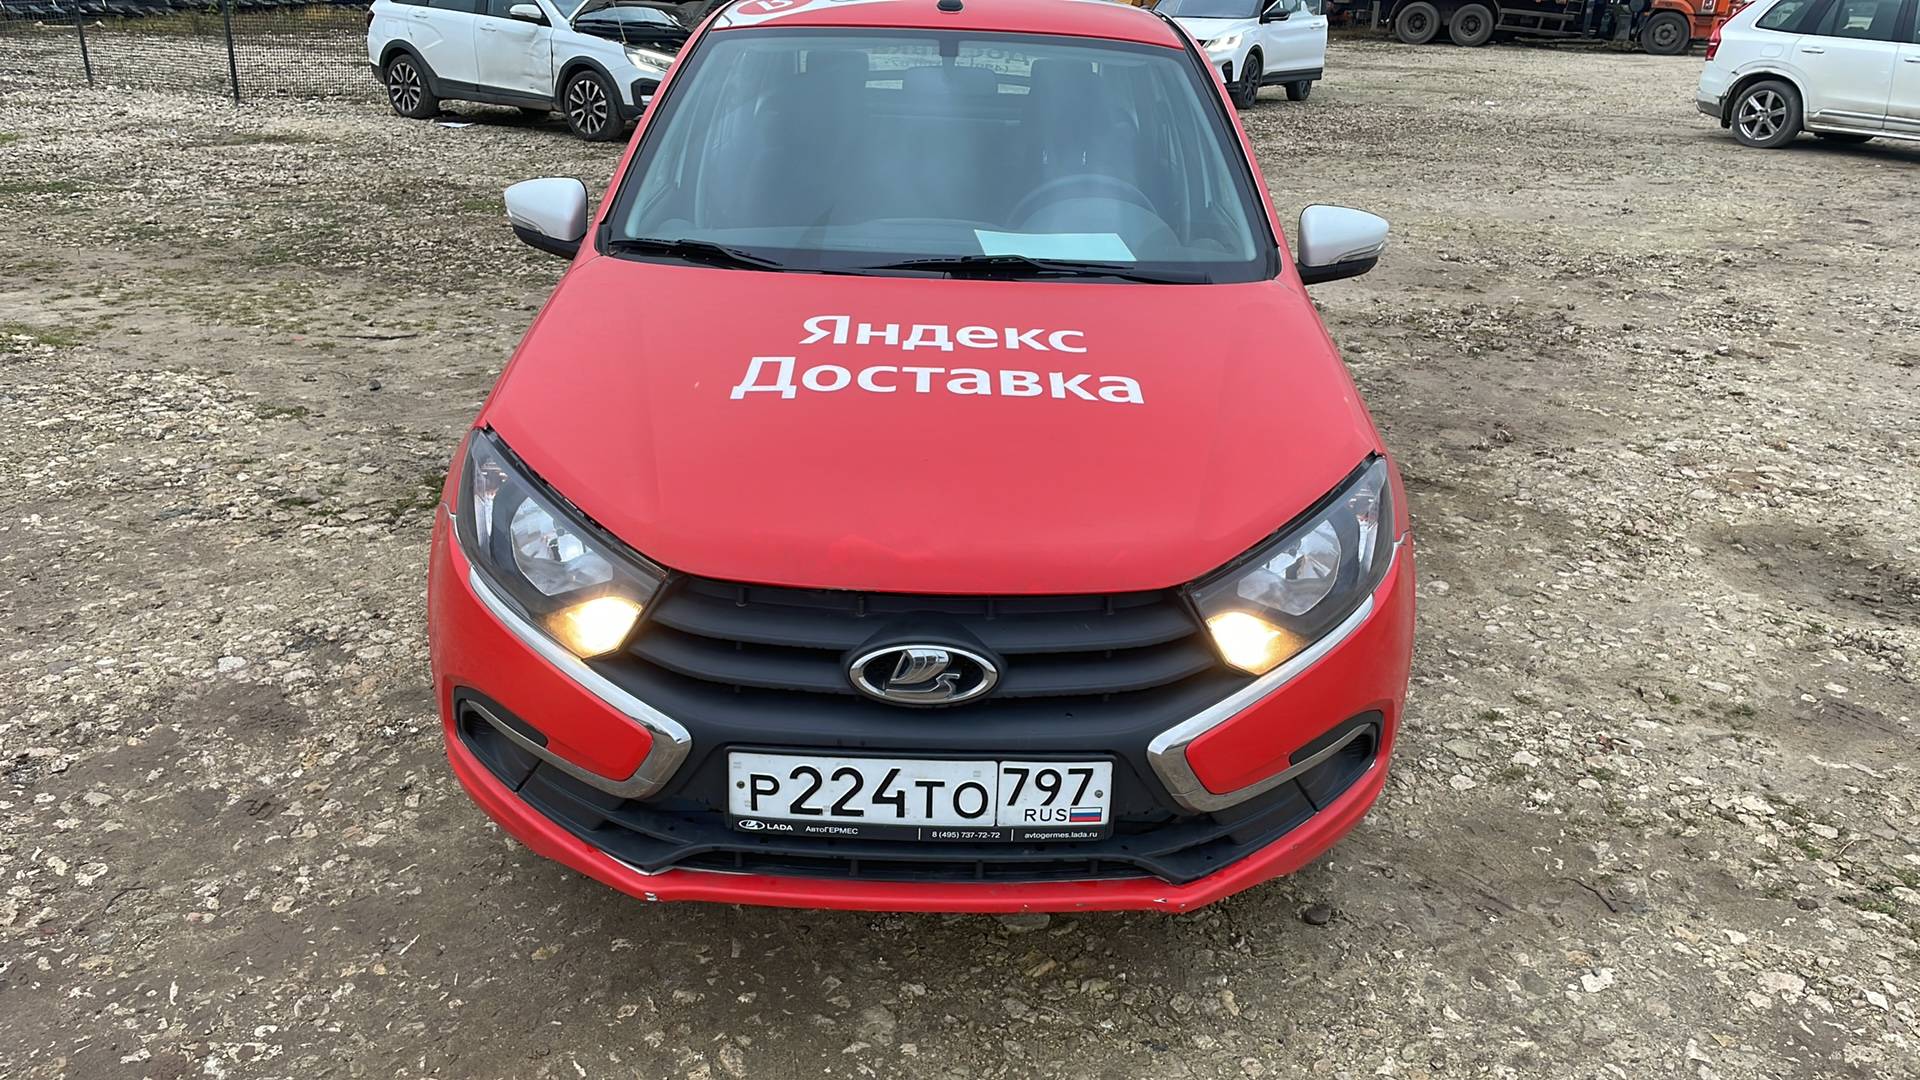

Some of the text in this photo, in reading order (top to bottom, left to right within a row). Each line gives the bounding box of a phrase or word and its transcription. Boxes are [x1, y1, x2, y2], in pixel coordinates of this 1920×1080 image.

[799, 315, 1088, 353] Яндекс
[730, 356, 1145, 404] Доставка
[1002, 767, 1094, 807] 797
[1024, 808, 1067, 822] RUS
[766, 823, 794, 832] LADA
[805, 825, 859, 835] АвтоГЕРМЕС
[938, 831, 960, 839] (495)
[1024, 831, 1098, 840] avtogermes.lada.ru
